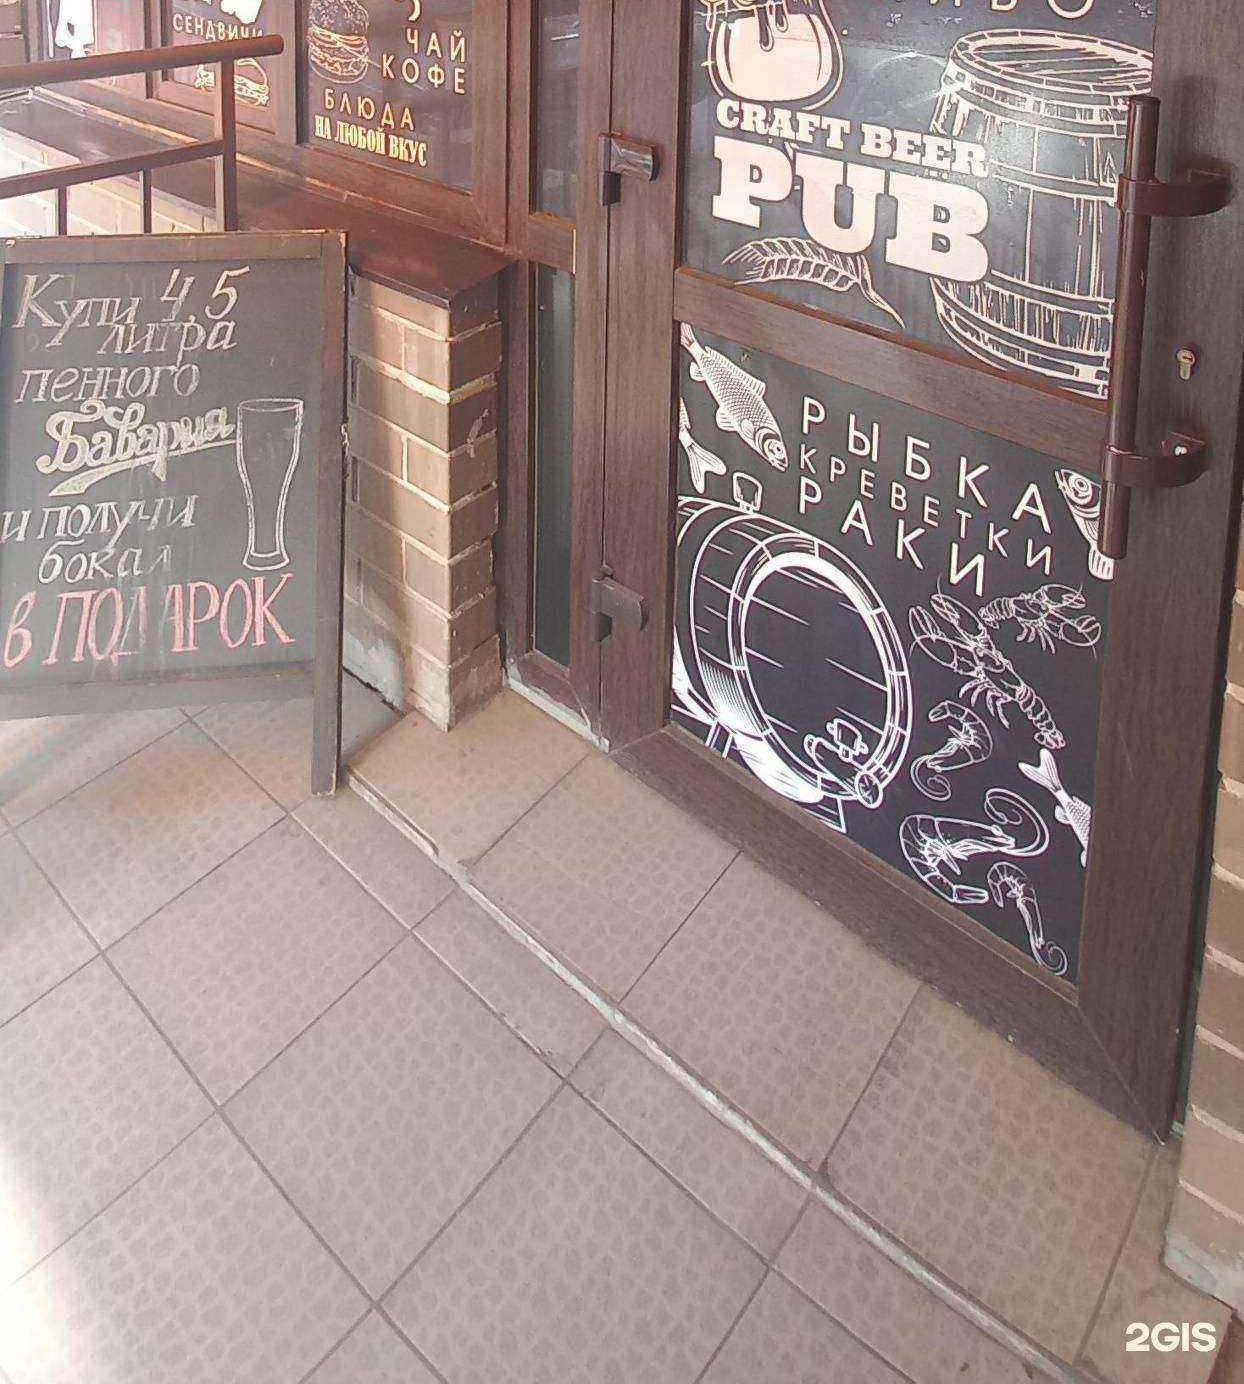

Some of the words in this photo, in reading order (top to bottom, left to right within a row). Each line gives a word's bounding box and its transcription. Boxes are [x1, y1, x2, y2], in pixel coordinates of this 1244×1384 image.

[382, 53, 466, 94] КОФЕ
[406, 27, 466, 63] ЧАЙ
[314, 114, 332, 141] НА
[335, 120, 386, 156] ЛЮБОЙ
[389, 134, 428, 167] ВКУС
[324, 88, 415, 131] БЛЮДА
[716, 99, 852, 151] CRAFT
[860, 125, 991, 178] BEER
[712, 136, 990, 283] PUB
[12, 274, 141, 348] Купи
[160, 266, 250, 324] 4,5
[97, 319, 238, 367] литра
[14, 364, 200, 403] пенного
[36, 398, 235, 483] Бавария
[802, 396, 1051, 534] РЫБКА
[37, 494, 199, 553] получи
[799, 478, 985, 597] РАКИ
[800, 444, 1051, 576] КРЕВЕТКИ
[38, 539, 175, 585] бокал
[42, 573, 296, 666] ПОДАРОК
